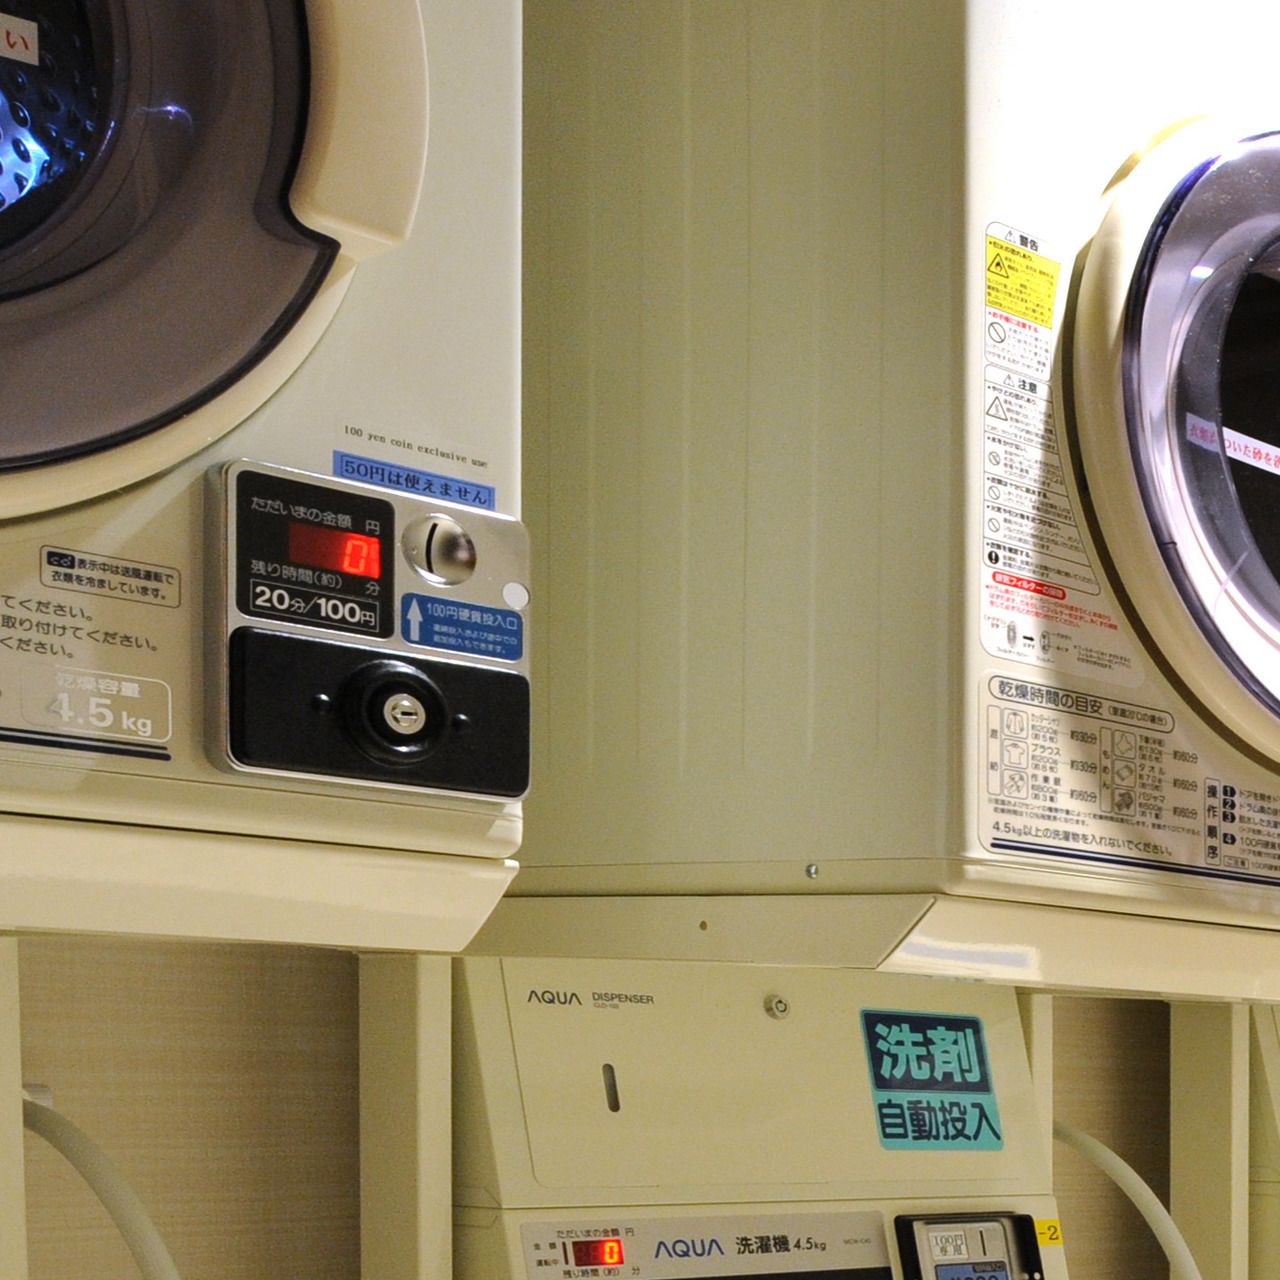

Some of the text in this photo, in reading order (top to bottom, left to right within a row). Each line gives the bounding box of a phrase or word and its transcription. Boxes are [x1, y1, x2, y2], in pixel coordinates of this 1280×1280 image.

[343, 425, 363, 438] 100
[368, 432, 386, 444] yen
[390, 437, 414, 451] coin
[417, 444, 468, 465] exclusive
[344, 459, 489, 505] 50円は使えません
[250, 496, 380, 535] ただいまの金額 円
[342, 538, 369, 575] 0
[254, 584, 376, 627] 20分/100円
[365, 582, 380, 597] 分
[999, 680, 1104, 716] 乾燥時間の目安
[121, 710, 153, 737] kg
[526, 989, 655, 1007] AQUA DISPENSER
[874, 1022, 982, 1083] 洗剤
[877, 1098, 1002, 1142] 自動投入
[603, 1241, 619, 1264] 0
[654, 1235, 827, 1259] AQUA 洗濯機 4.5kg
